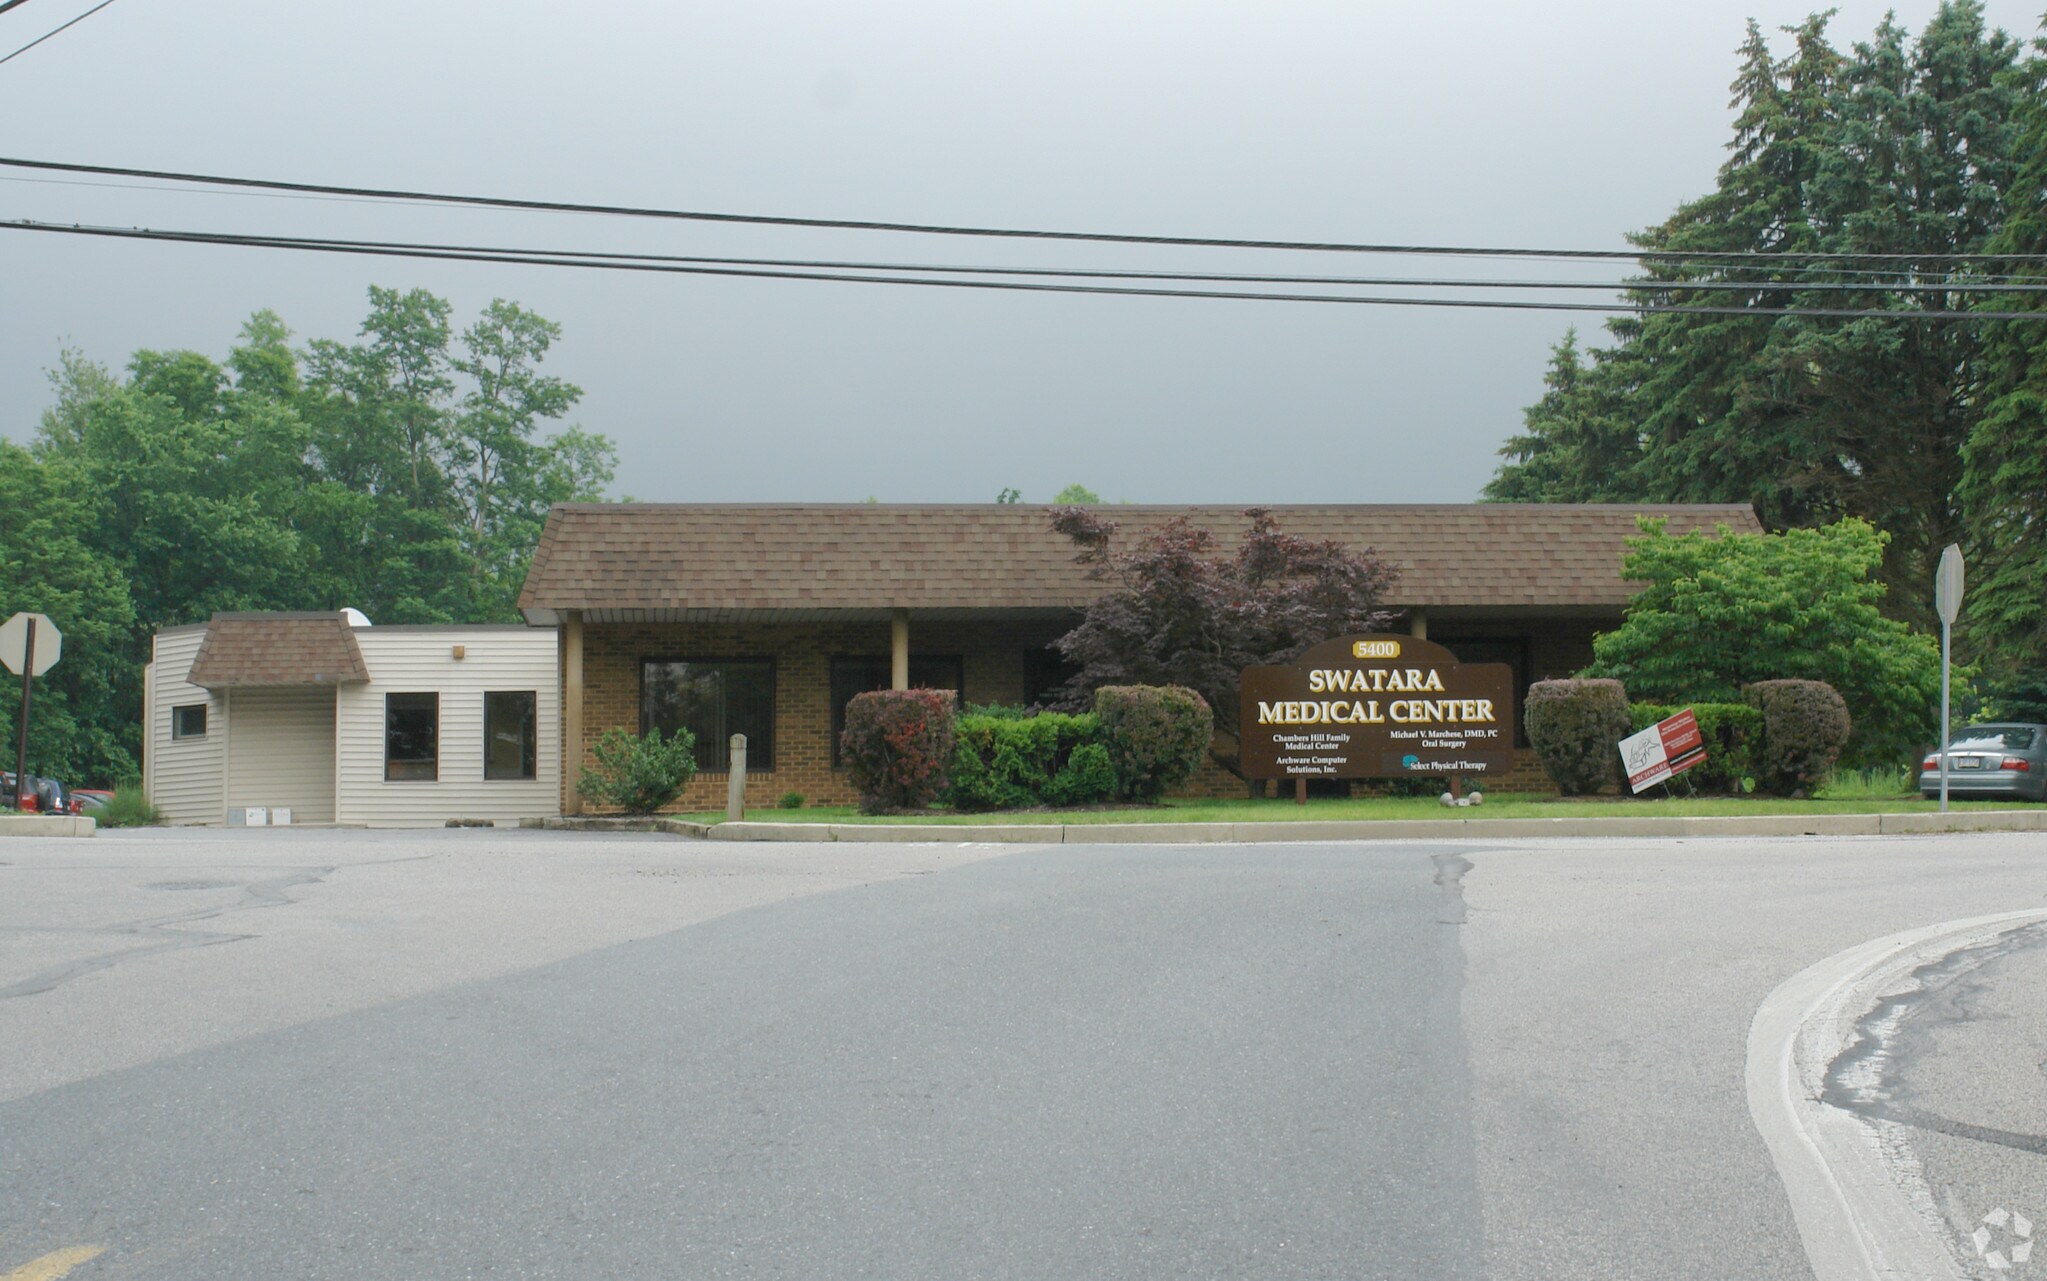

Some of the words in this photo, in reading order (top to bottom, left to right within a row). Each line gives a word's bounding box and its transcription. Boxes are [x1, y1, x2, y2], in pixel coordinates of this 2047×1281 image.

[1358, 642, 1394, 656] 5400
[1309, 669, 1445, 692] SWATARA
[1258, 700, 1385, 724] MEDICAL
[1389, 699, 1495, 722] CENTER
[1273, 734, 1309, 742] Chambers
[1310, 733, 1325, 742] Hill
[1326, 733, 1350, 743] Family
[1390, 730, 1418, 739] Michael
[1420, 730, 1427, 738] V.
[1428, 730, 1463, 738] Marchese,
[1464, 729, 1486, 738] DMD,
[1487, 729, 1498, 737] PC
[1285, 742, 1314, 750] Medical
[1315, 742, 1339, 750] Center
[1422, 740, 1437, 748] Oral
[1439, 740, 1466, 748] Surgery
[1276, 756, 1310, 764] Archware
[1311, 756, 1347, 765] Computer
[1410, 761, 1430, 771] Select
[1431, 761, 1458, 771] Physical
[1459, 760, 1486, 771] Therapy
[1286, 766, 1322, 774] Solutions,
